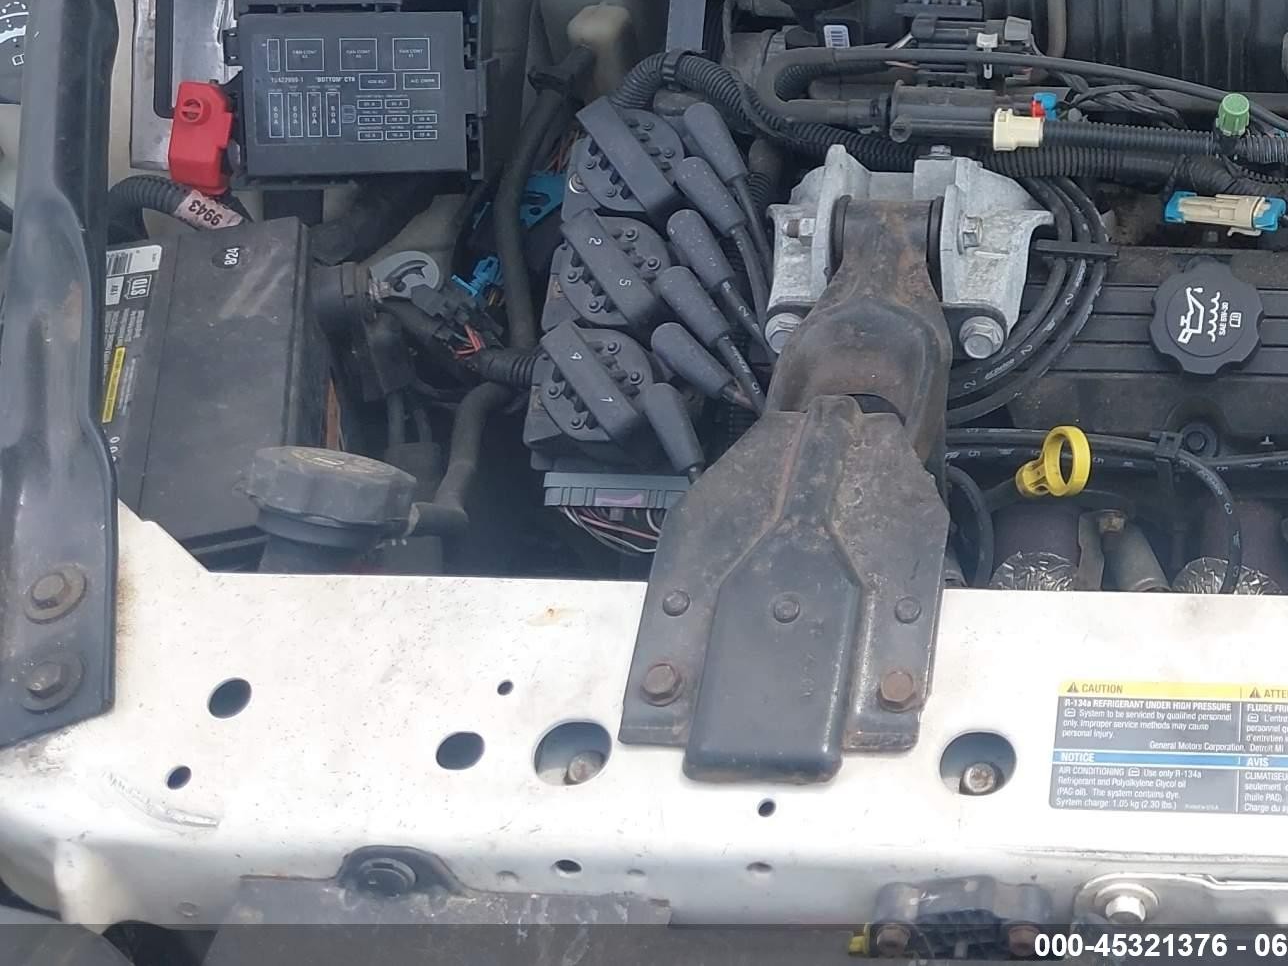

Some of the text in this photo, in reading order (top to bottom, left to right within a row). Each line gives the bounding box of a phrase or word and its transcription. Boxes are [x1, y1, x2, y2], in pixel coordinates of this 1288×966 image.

[188, 199, 223, 227] 9943
[588, 236, 602, 246] 2
[224, 246, 240, 266] 8/24
[130, 278, 148, 296] STD
[619, 278, 632, 288] 5
[1065, 293, 1074, 305] 2
[1219, 322, 1227, 336] SAE
[1020, 345, 1033, 355] 2
[570, 352, 583, 361] 4
[1082, 684, 1123, 694] CAUTION
[1064, 699, 1092, 707] R-134a
[1093, 700, 1143, 708] REFRIGERANT
[1173, 702, 1191, 710] HIGH
[1192, 702, 1231, 710] PRESSURE
[1247, 704, 1273, 712] FLUIDE
[1079, 709, 1105, 718] System
[1115, 710, 1124, 718] be
[1126, 710, 1155, 719] serviced
[1157, 710, 1164, 720] by
[1166, 711, 1196, 721] qualified
[1198, 712, 1232, 722] personnel
[1063, 719, 1209, 731] only. Improper service methods may cause
[1246, 725, 1280, 734] personnel
[1062, 730, 1114, 739] personal injury.
[1150, 741, 1176, 749] General
[1178, 742, 1202, 750] Motors
[1250, 744, 1273, 753] Detroit
[1061, 752, 1095, 762] NOTICE
[1246, 757, 1269, 767] AVIS
[1059, 766, 1071, 775] AIR
[1072, 767, 1124, 776] CONDITIONING
[1159, 769, 1173, 779] only
[1175, 770, 1202, 779] R-134a
[1058, 777, 1096, 787] Refrigerant
[1097, 778, 1109, 786] and
[1111, 778, 1154, 788] Polyalkylene
[1155, 779, 1177, 789] Glycol
[1245, 783, 1281, 791] seulement
[1057, 788, 1073, 797] (PAG
[1093, 788, 1105, 796] The
[1107, 790, 1132, 799] system
[1134, 789, 1164, 798] contains
[1244, 793, 1264, 803] (huile
[1056, 797, 1082, 807] System
[1113, 799, 1128, 808] 1.05
[1130, 799, 1139, 810] kg
[1141, 799, 1161, 809] (2.30
[1244, 803, 1269, 813] Charge
[1271, 804, 1280, 812] du
